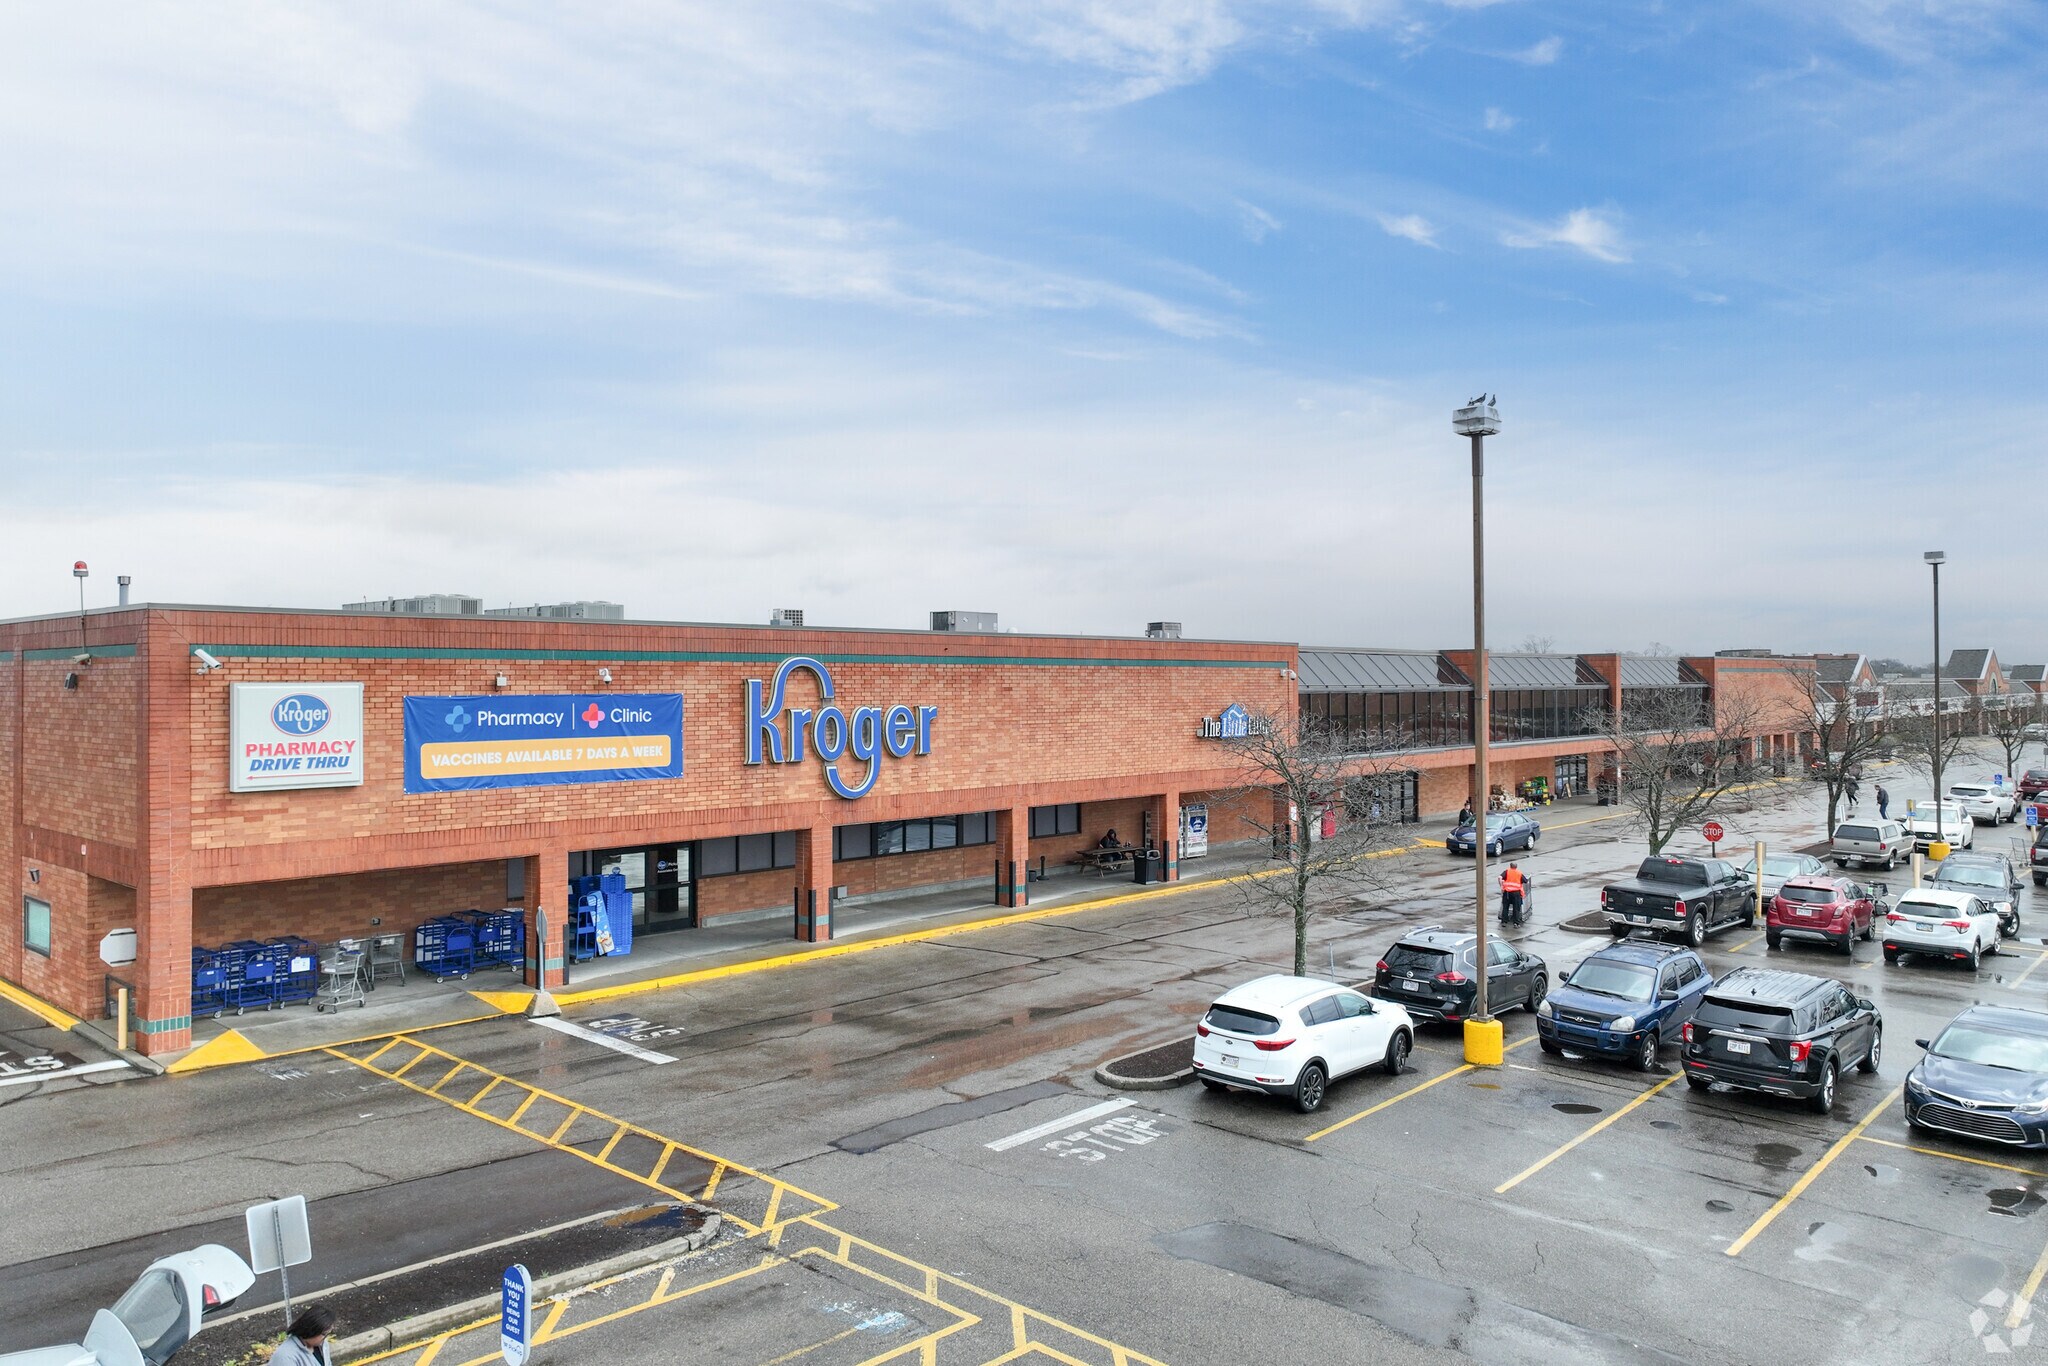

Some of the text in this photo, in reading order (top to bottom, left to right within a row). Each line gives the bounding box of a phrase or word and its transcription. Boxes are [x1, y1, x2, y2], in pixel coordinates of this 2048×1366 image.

[278, 698, 328, 733] Kroger
[477, 708, 652, 728] Pharmacy Clinic
[744, 656, 938, 799] Kroger
[1203, 717, 1220, 737] The
[1222, 716, 1247, 737] Little
[245, 740, 356, 757] PHARMACY
[431, 745, 663, 767] VACCINES AVAILABLE 7 DAYS A WEEK
[249, 755, 350, 772] DRIVE THRU
[1703, 827, 1723, 836] STOP
[504, 1278, 524, 1293] THANK
[508, 1289, 520, 1300] YOU
[506, 1307, 520, 1318] BEING
[509, 1300, 518, 1309] FOR
[508, 1316, 518, 1325] OUR
[505, 1324, 520, 1335] GUEST
